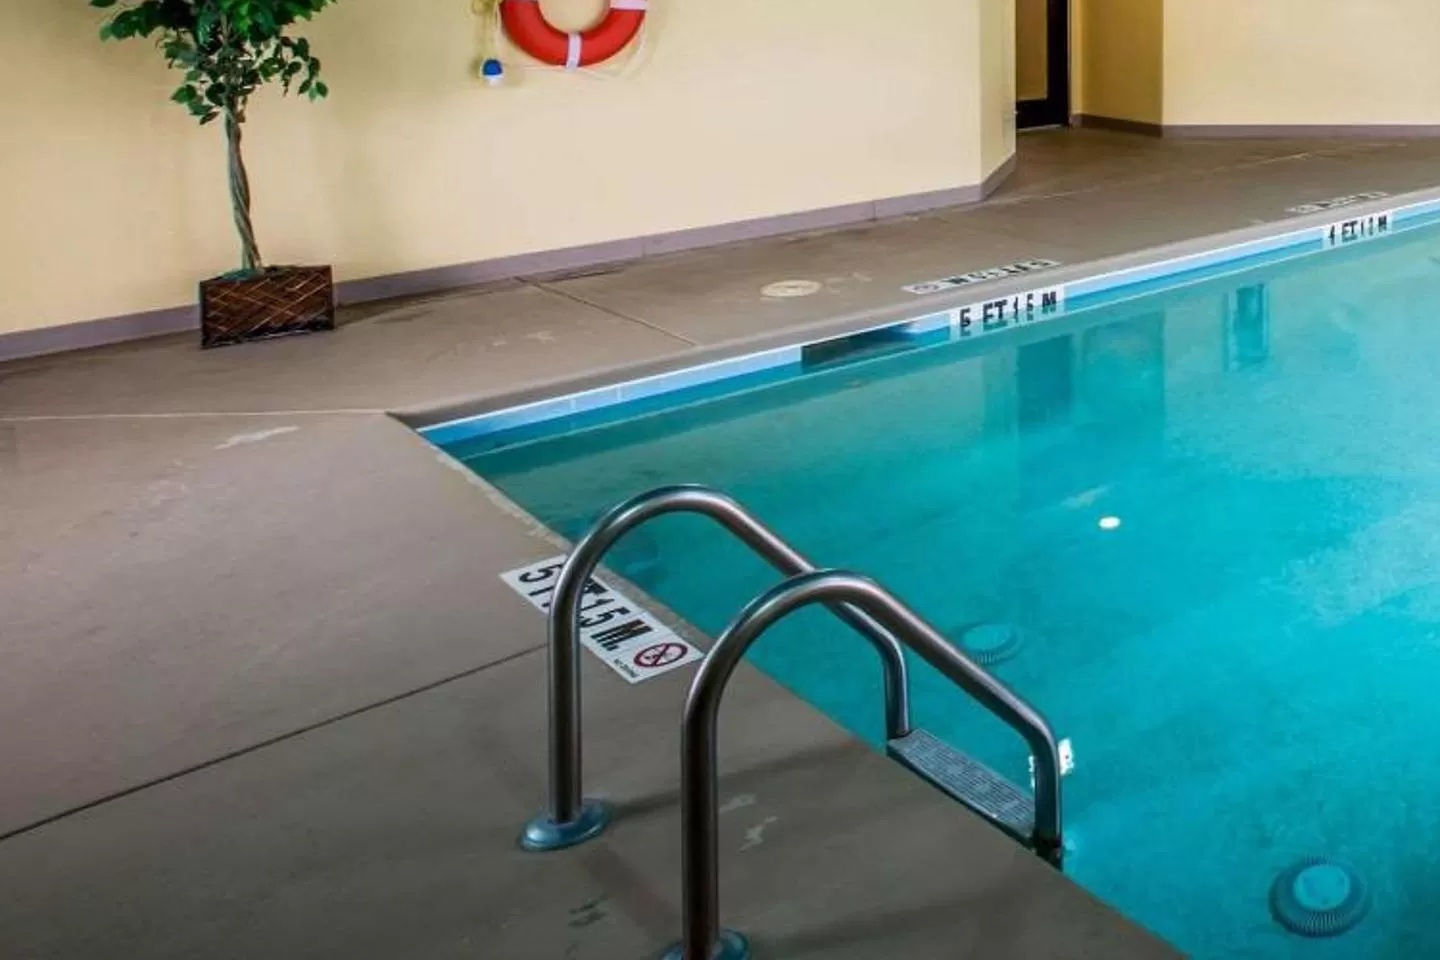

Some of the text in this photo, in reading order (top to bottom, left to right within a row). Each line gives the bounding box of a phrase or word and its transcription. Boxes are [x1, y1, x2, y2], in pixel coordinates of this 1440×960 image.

[982, 299, 1007, 326] FT
[1042, 291, 1057, 311] M
[518, 562, 564, 582] 5
